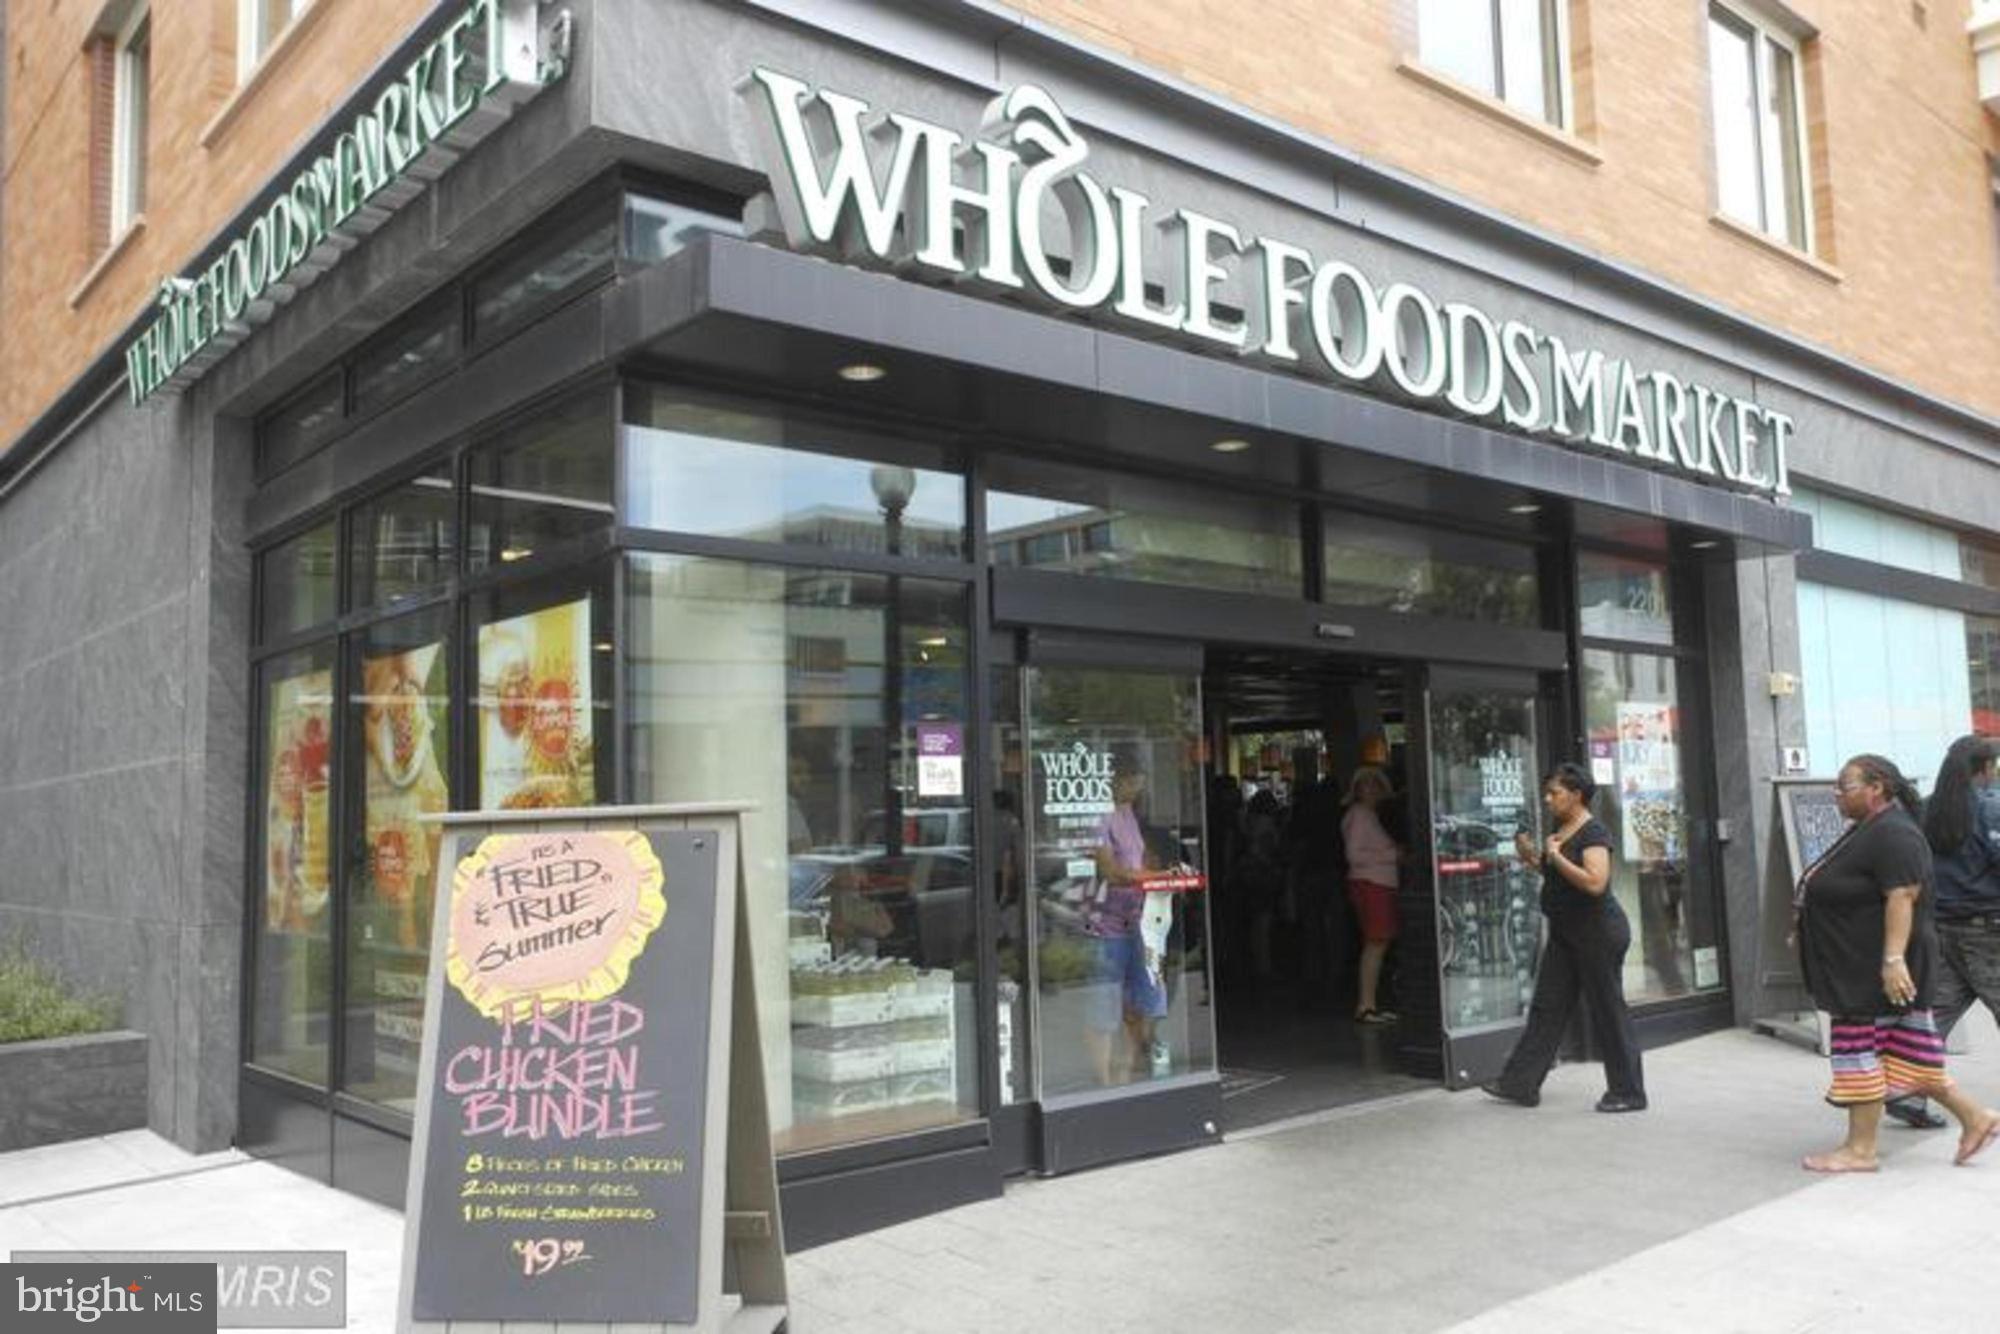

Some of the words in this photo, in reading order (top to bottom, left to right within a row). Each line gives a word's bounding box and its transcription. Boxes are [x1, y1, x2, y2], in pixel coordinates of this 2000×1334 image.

[126, 275, 207, 405] WHOLE
[207, 168, 311, 338] FOODS
[311, 0, 505, 243] MARKET
[755, 66, 1250, 351] WHOLE
[1257, 236, 1541, 430] FOODS
[1547, 334, 1794, 497] MARKET
[1041, 742, 1115, 777] WHOLE
[1046, 778, 1113, 801] FOODS
[561, 839, 575, 856] A
[493, 882, 597, 929] TRUE
[476, 908, 617, 972] Summer
[495, 993, 643, 1045] FRIED
[445, 1044, 638, 1096] CHICKEN
[461, 1091, 666, 1140] BUNDLE
[460, 1180, 481, 1197] 2
[463, 1205, 472, 1221] 1
